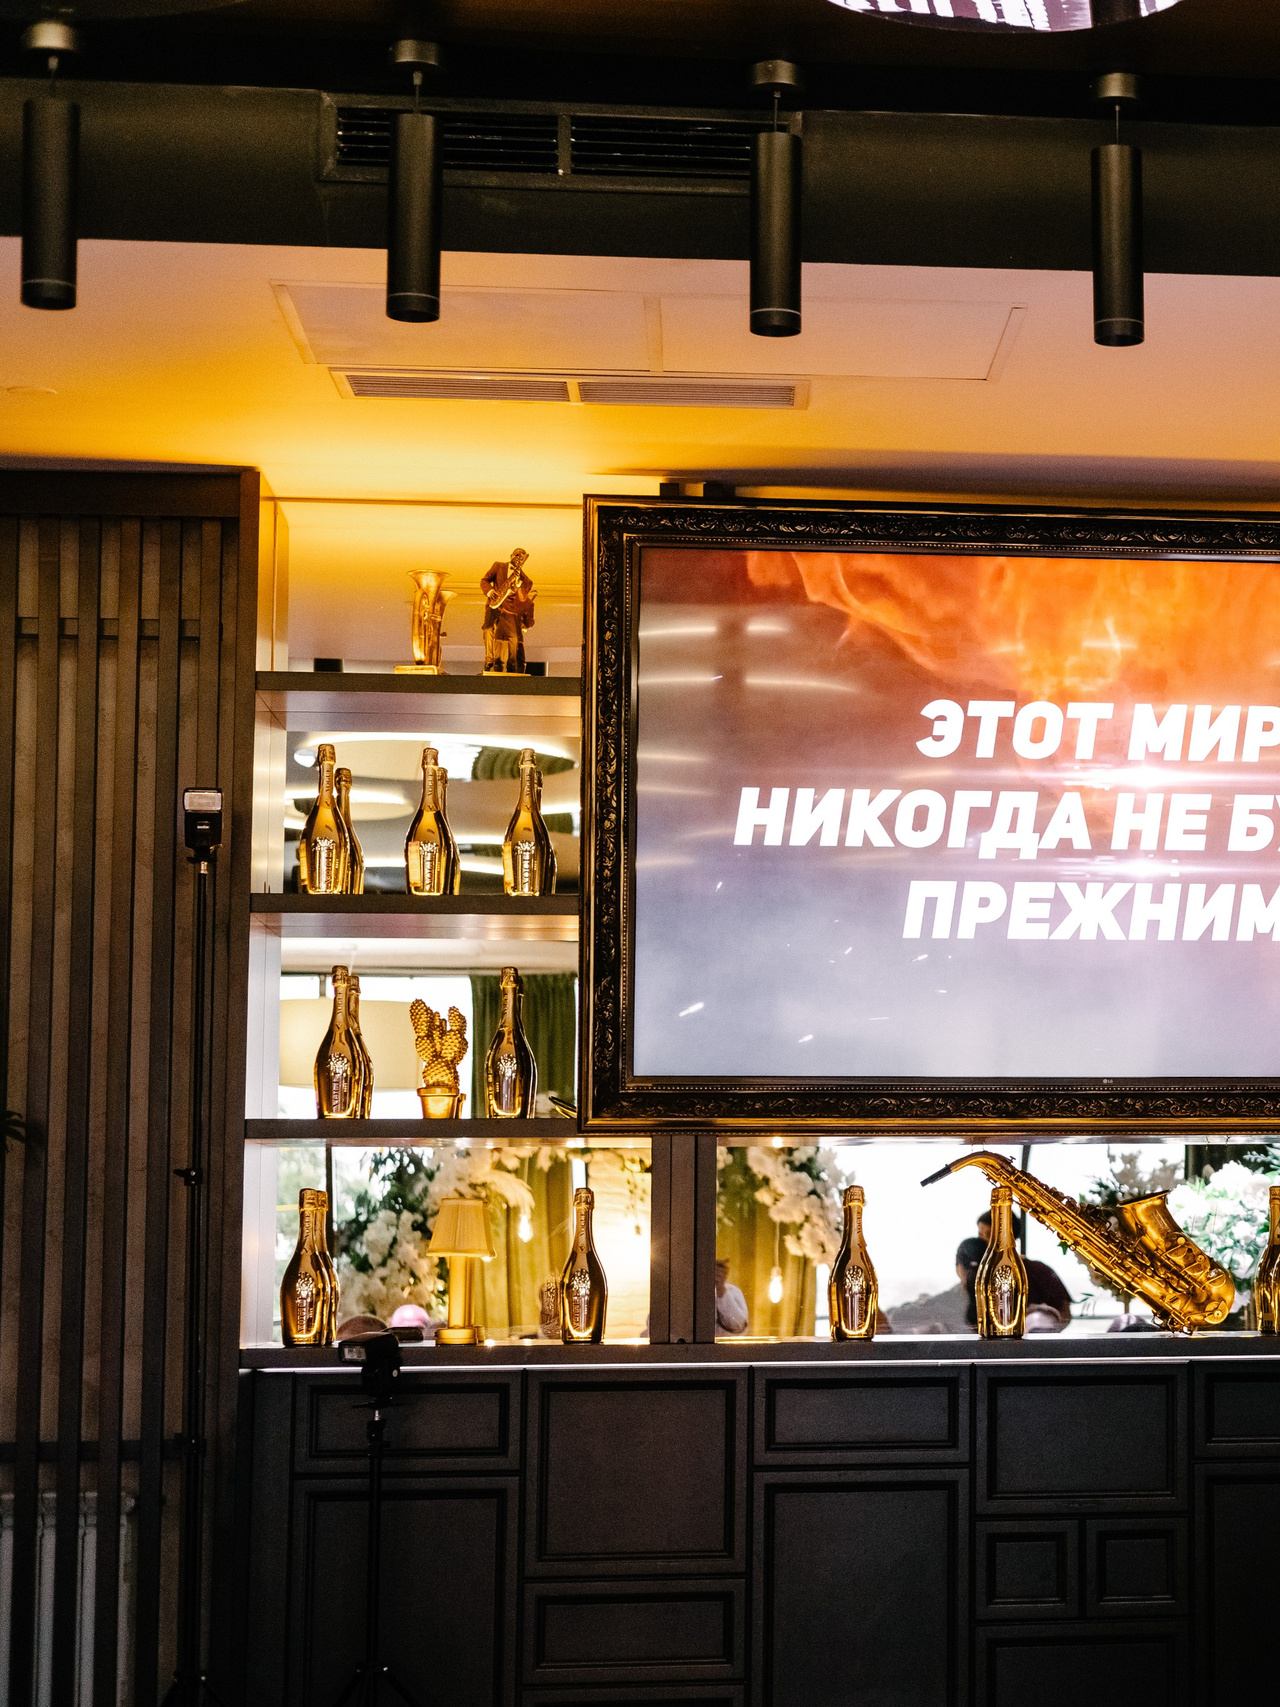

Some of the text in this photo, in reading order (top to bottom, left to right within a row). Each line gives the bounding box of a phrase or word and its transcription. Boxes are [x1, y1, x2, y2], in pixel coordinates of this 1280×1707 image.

[916, 699, 1114, 760] ЭТОТ
[733, 787, 1092, 860] НИКОГДА
[1110, 792, 1212, 851] НЕ
